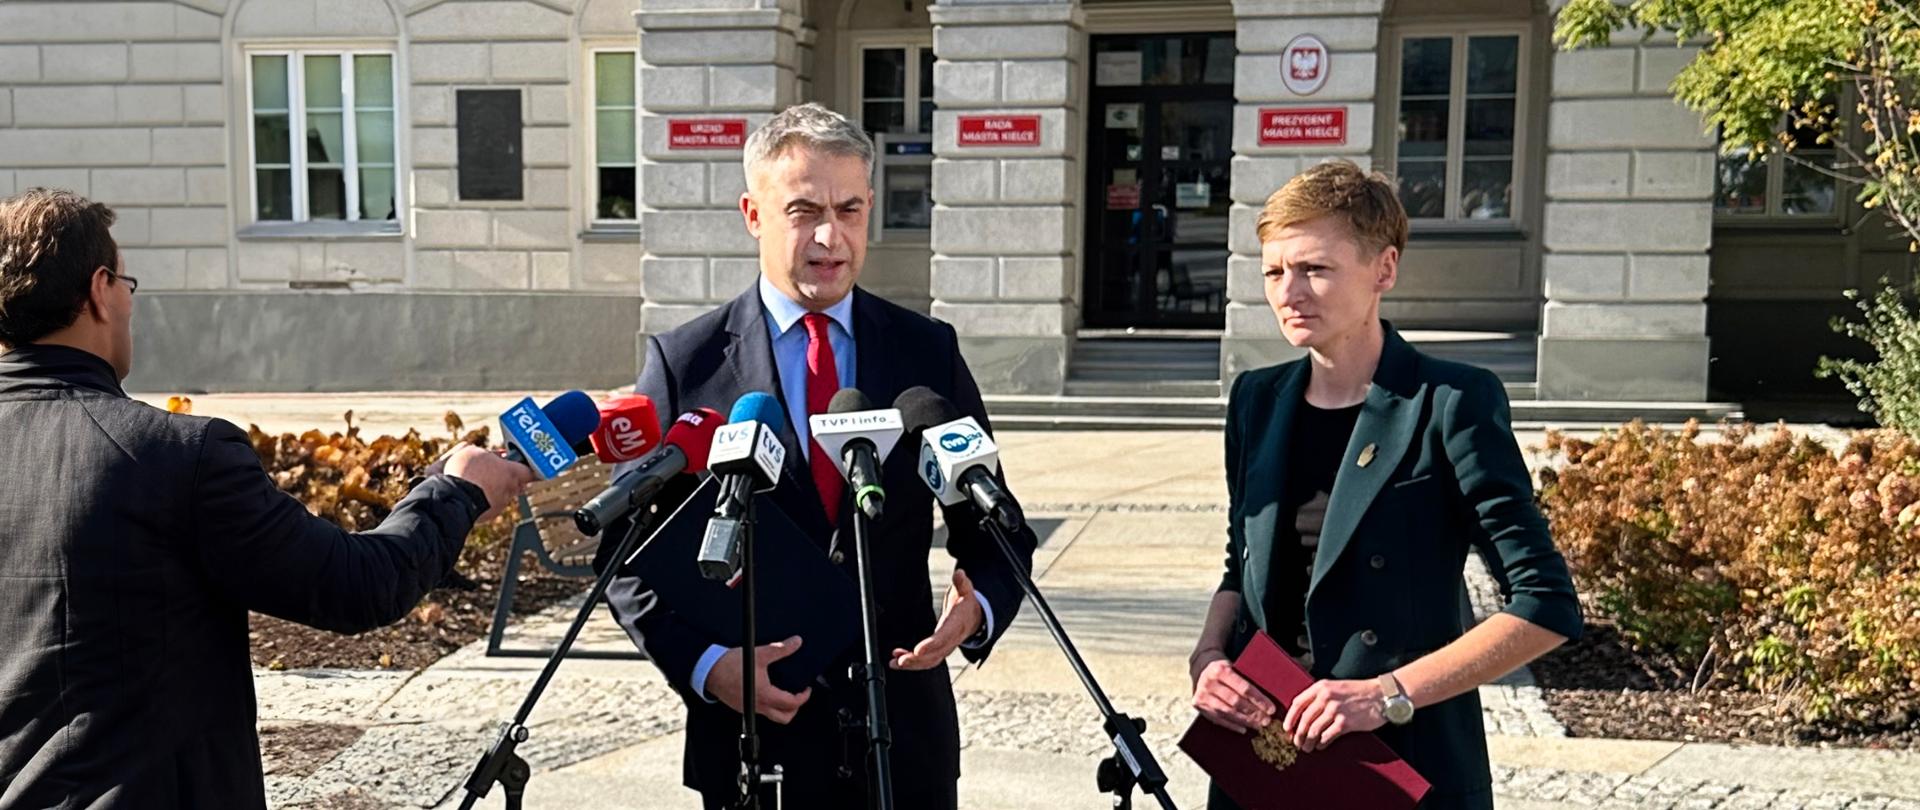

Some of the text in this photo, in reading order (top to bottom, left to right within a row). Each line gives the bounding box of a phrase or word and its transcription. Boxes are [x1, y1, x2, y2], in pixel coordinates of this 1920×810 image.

[984, 120, 1013, 130] RADA
[1272, 114, 1333, 126] PREZYDENT
[962, 131, 1034, 141] MIASTA KIELCE
[1263, 126, 1341, 138] MIASTA KIELCE
[820, 419, 848, 427] TVP
